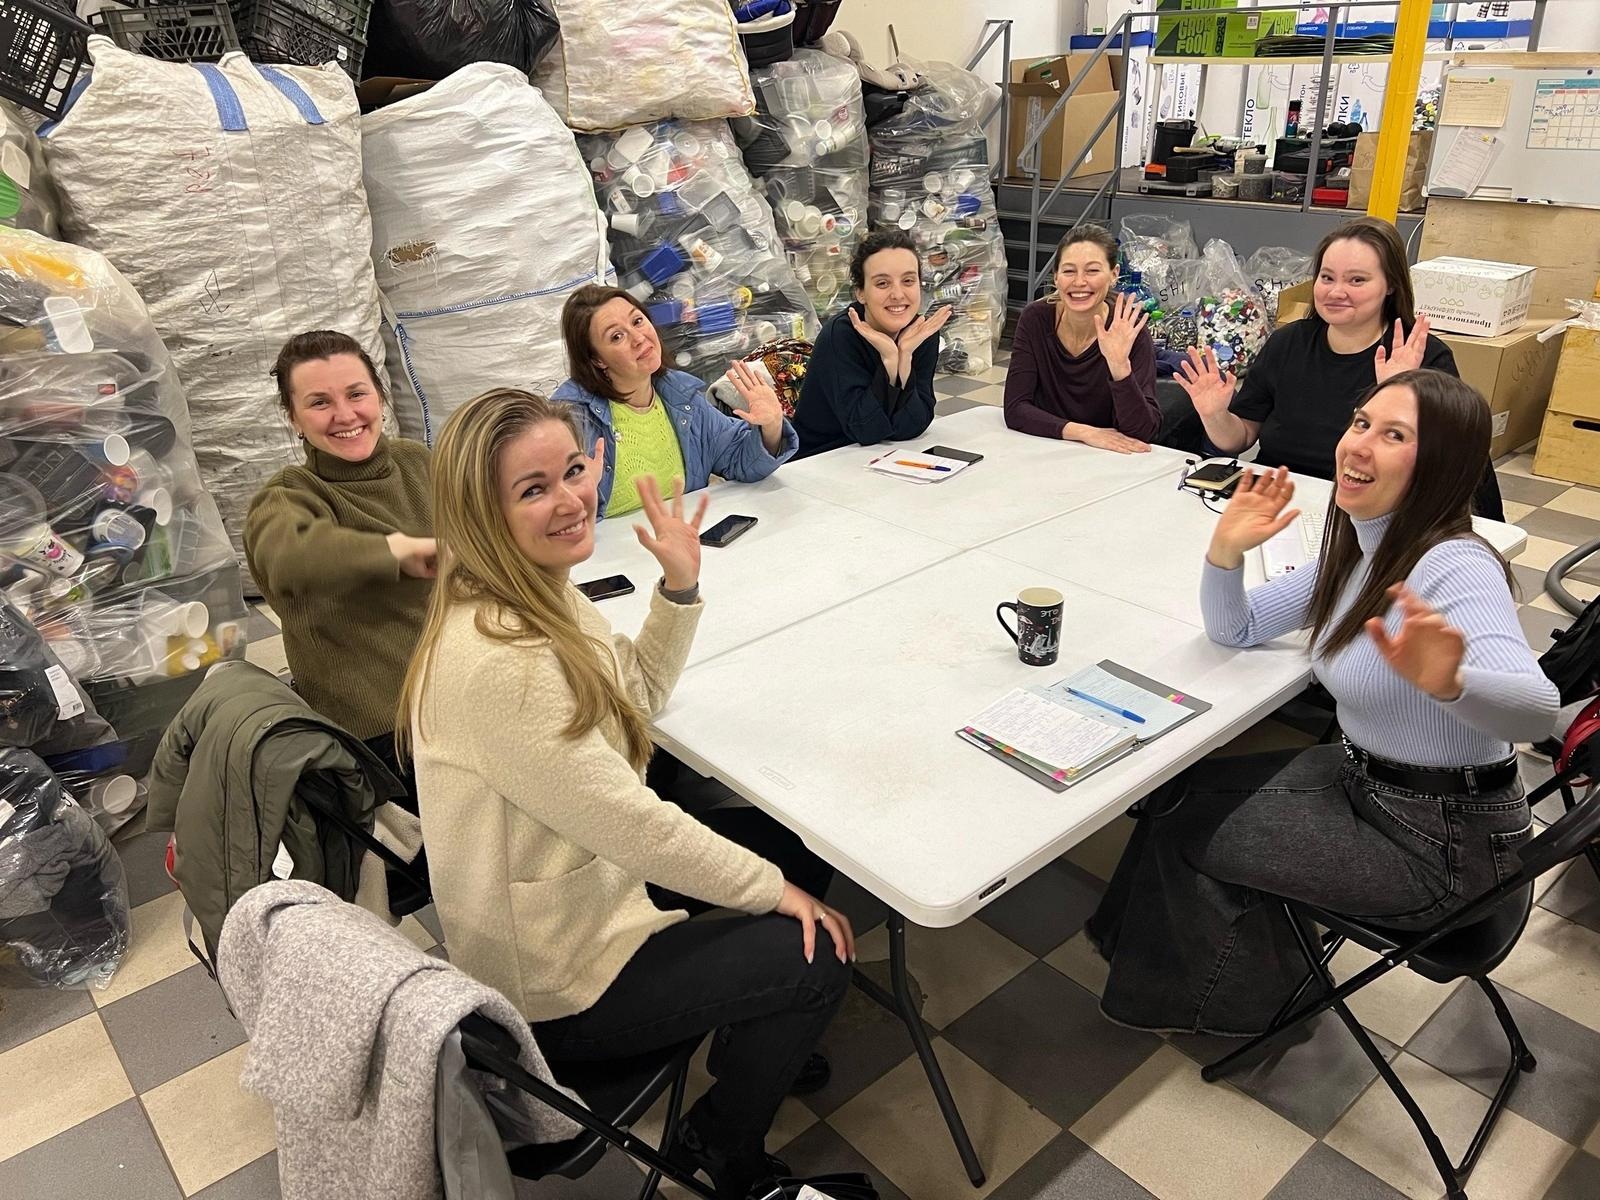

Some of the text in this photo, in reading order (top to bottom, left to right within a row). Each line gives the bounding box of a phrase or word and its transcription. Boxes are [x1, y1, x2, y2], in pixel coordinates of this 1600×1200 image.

[1176, 33, 1209, 54] FOOD
[1243, 99, 1255, 139] ТЕКЛО
[1447, 316, 1492, 328] Приятного
